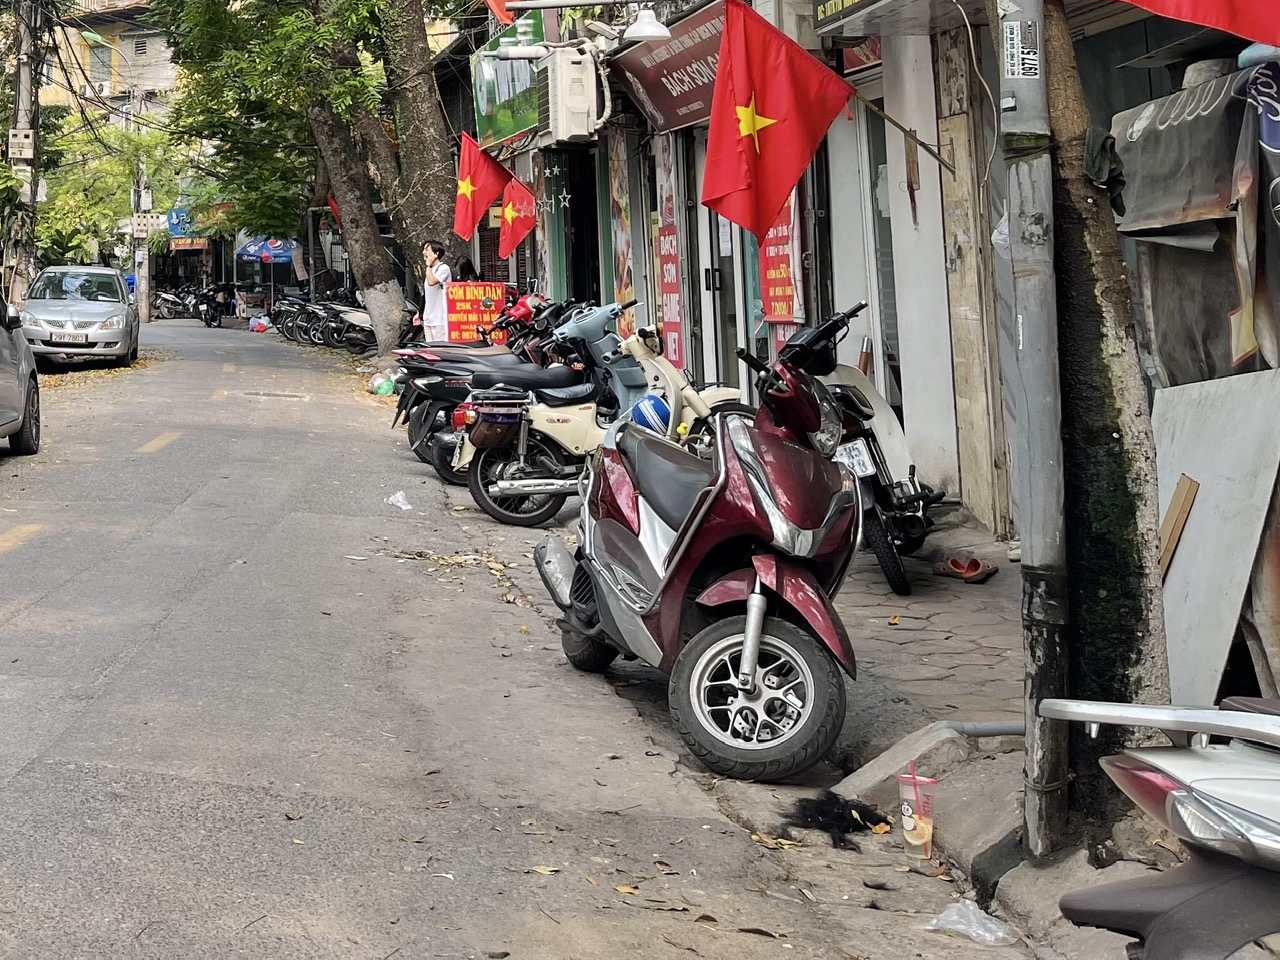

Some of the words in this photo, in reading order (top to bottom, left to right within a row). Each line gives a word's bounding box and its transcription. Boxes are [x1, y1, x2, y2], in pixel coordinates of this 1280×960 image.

[660, 68, 697, 98] BÁCH
[686, 59, 714, 86] SƠN
[660, 231, 677, 256] BÁCH
[663, 262, 677, 283] SƠN
[456, 302, 472, 311] 25K
[663, 293, 680, 323] GAME
[667, 332, 679, 361] NET
